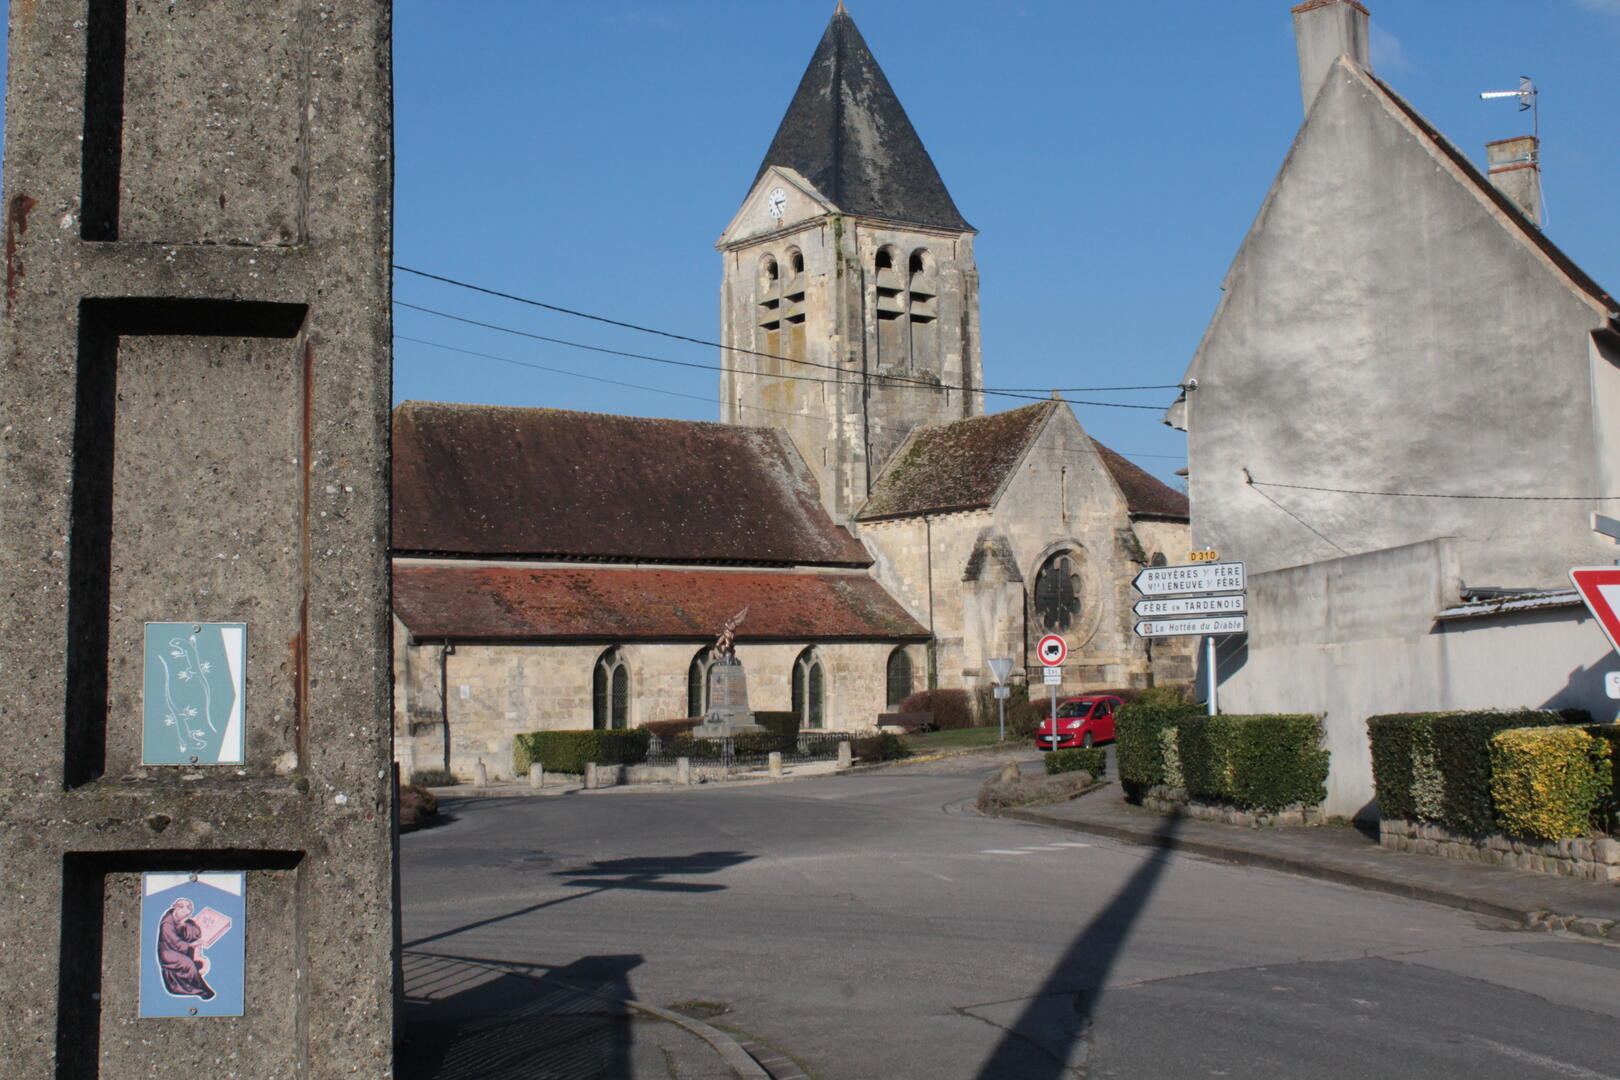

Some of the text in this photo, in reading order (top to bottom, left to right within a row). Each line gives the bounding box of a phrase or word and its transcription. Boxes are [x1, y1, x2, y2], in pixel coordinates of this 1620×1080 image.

[1148, 569, 1199, 581] BRUYÈRES
[1214, 566, 1240, 577] FÈRE
[1217, 577, 1240, 587] FÈRE
[1143, 602, 1168, 612] FÈRE
[1185, 599, 1241, 611] TARDENOIS
[1155, 620, 1241, 633] La Hottée du Diable
